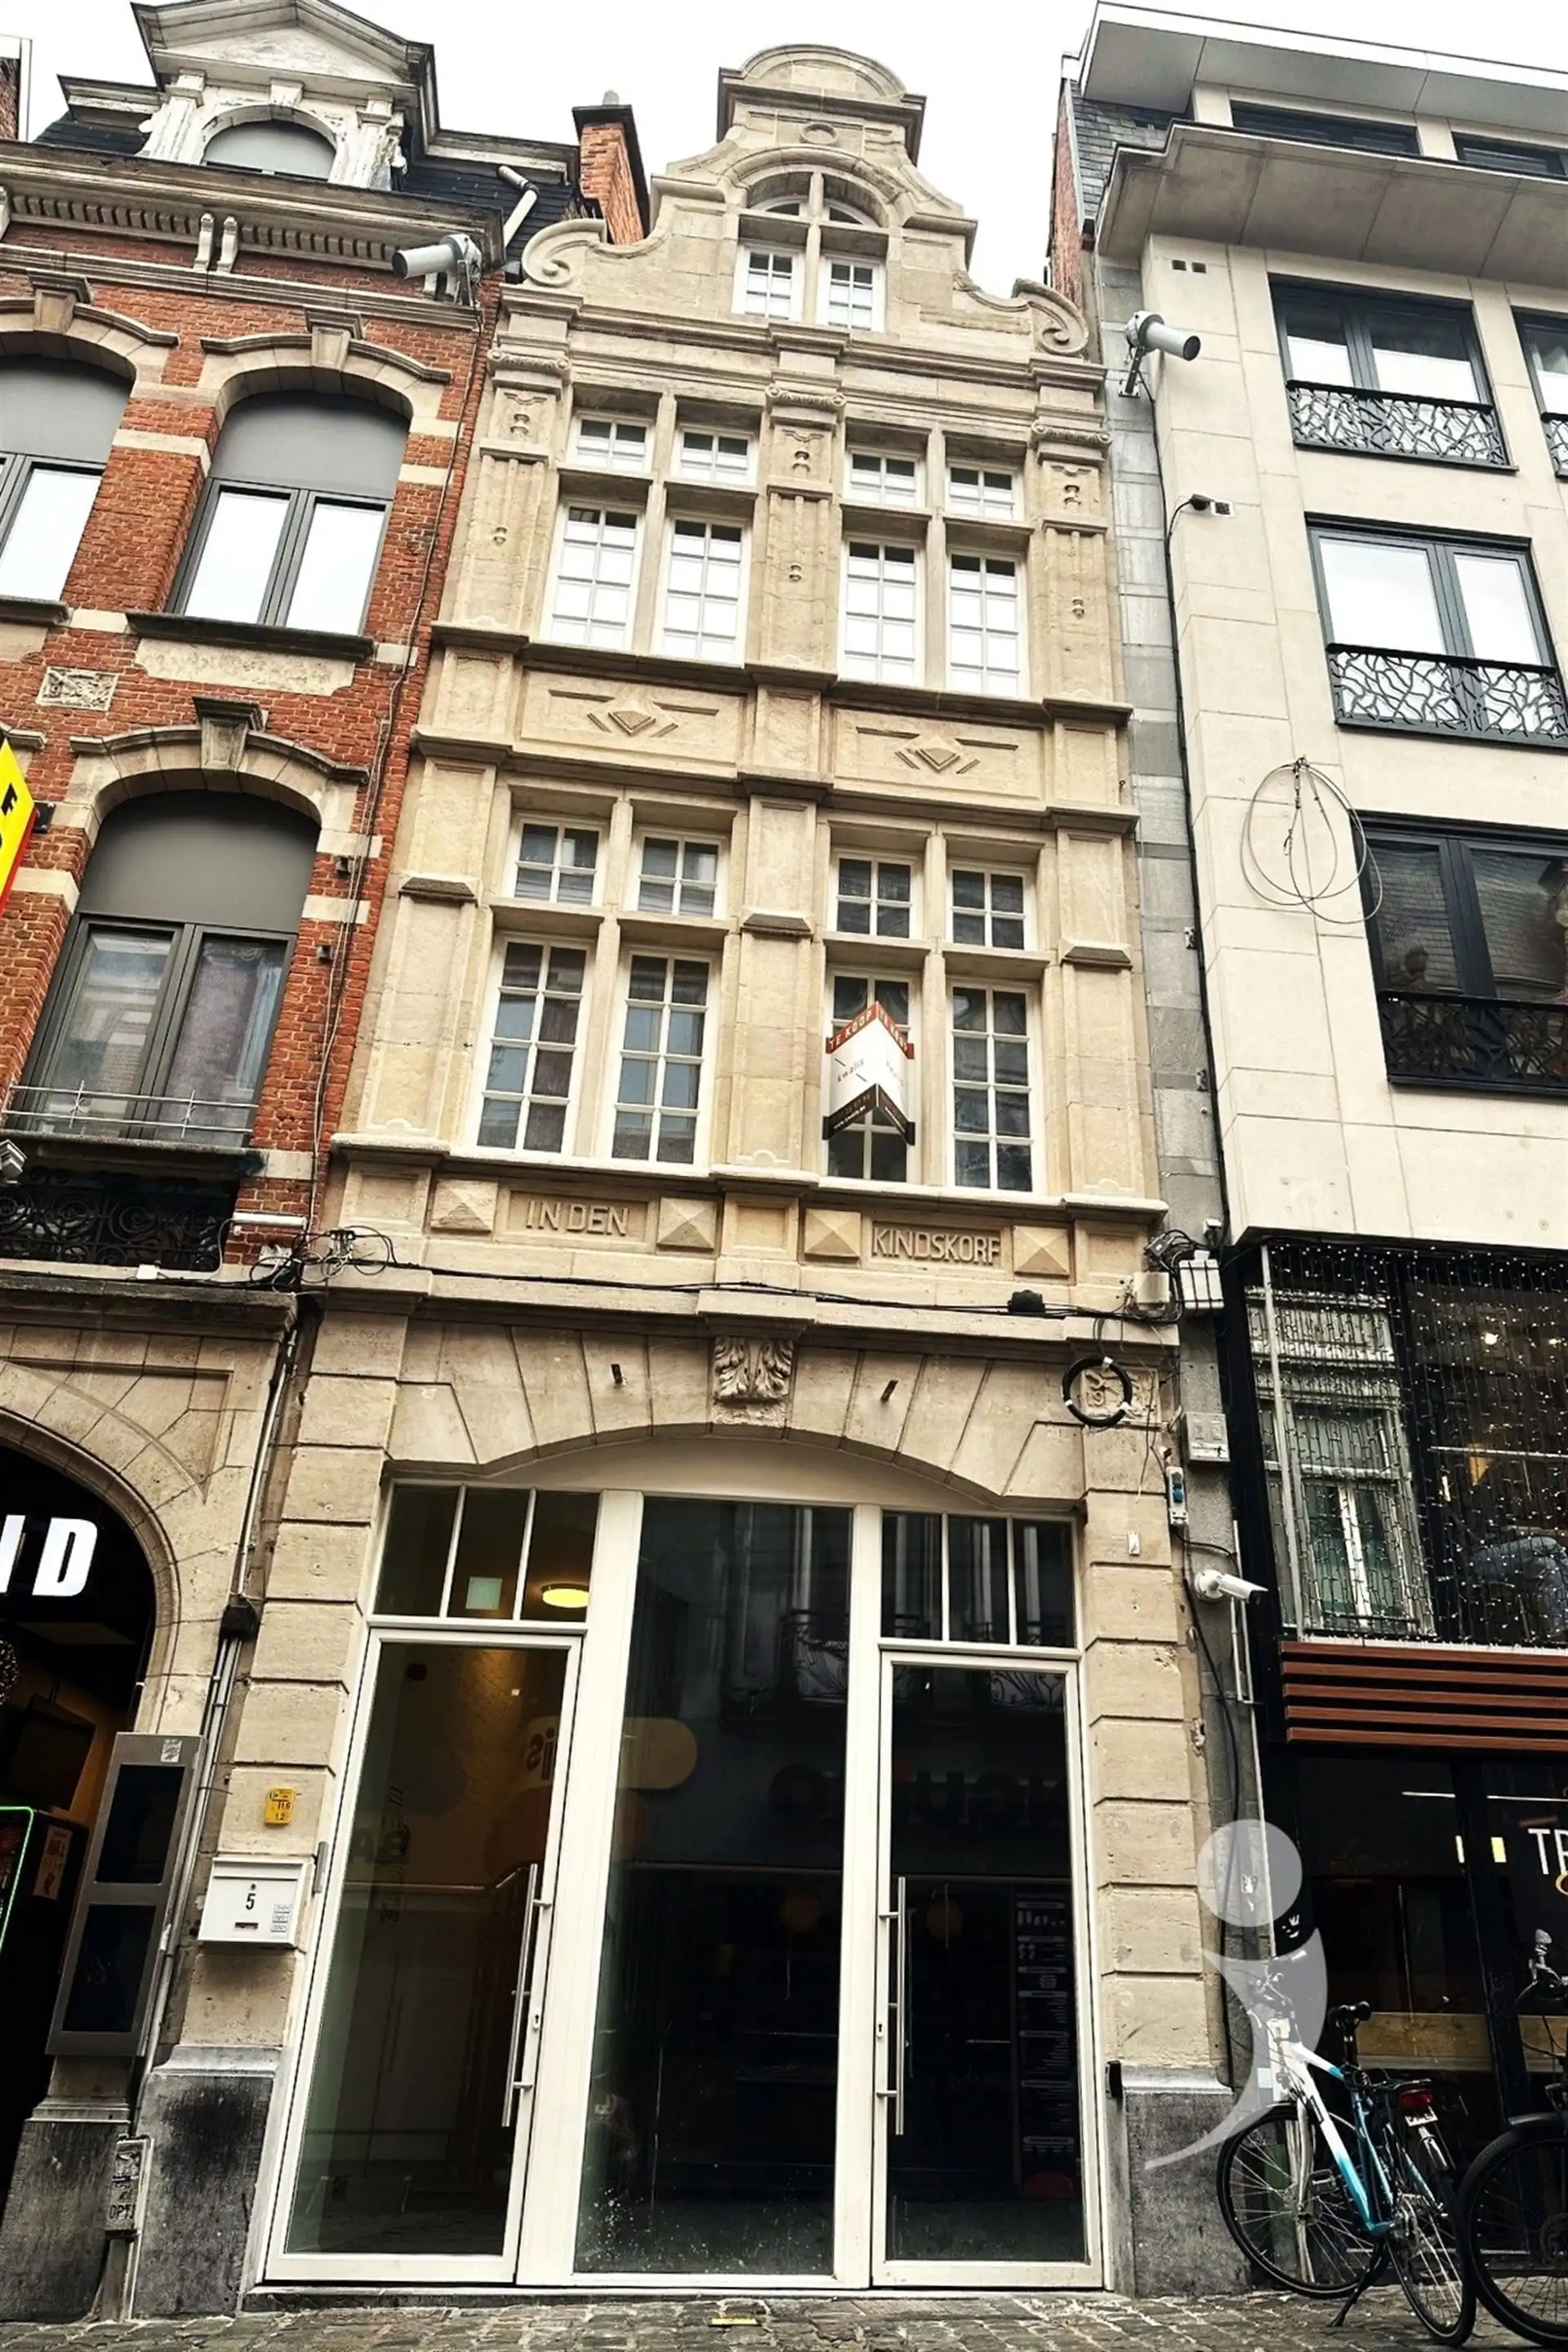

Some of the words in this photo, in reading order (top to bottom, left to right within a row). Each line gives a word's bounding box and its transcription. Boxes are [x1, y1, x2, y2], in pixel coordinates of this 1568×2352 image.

[526, 1200, 562, 1231] IN
[566, 1203, 631, 1236] DEN
[871, 1227, 1001, 1266] KINDSKORF
[245, 1892, 256, 1910] 5
